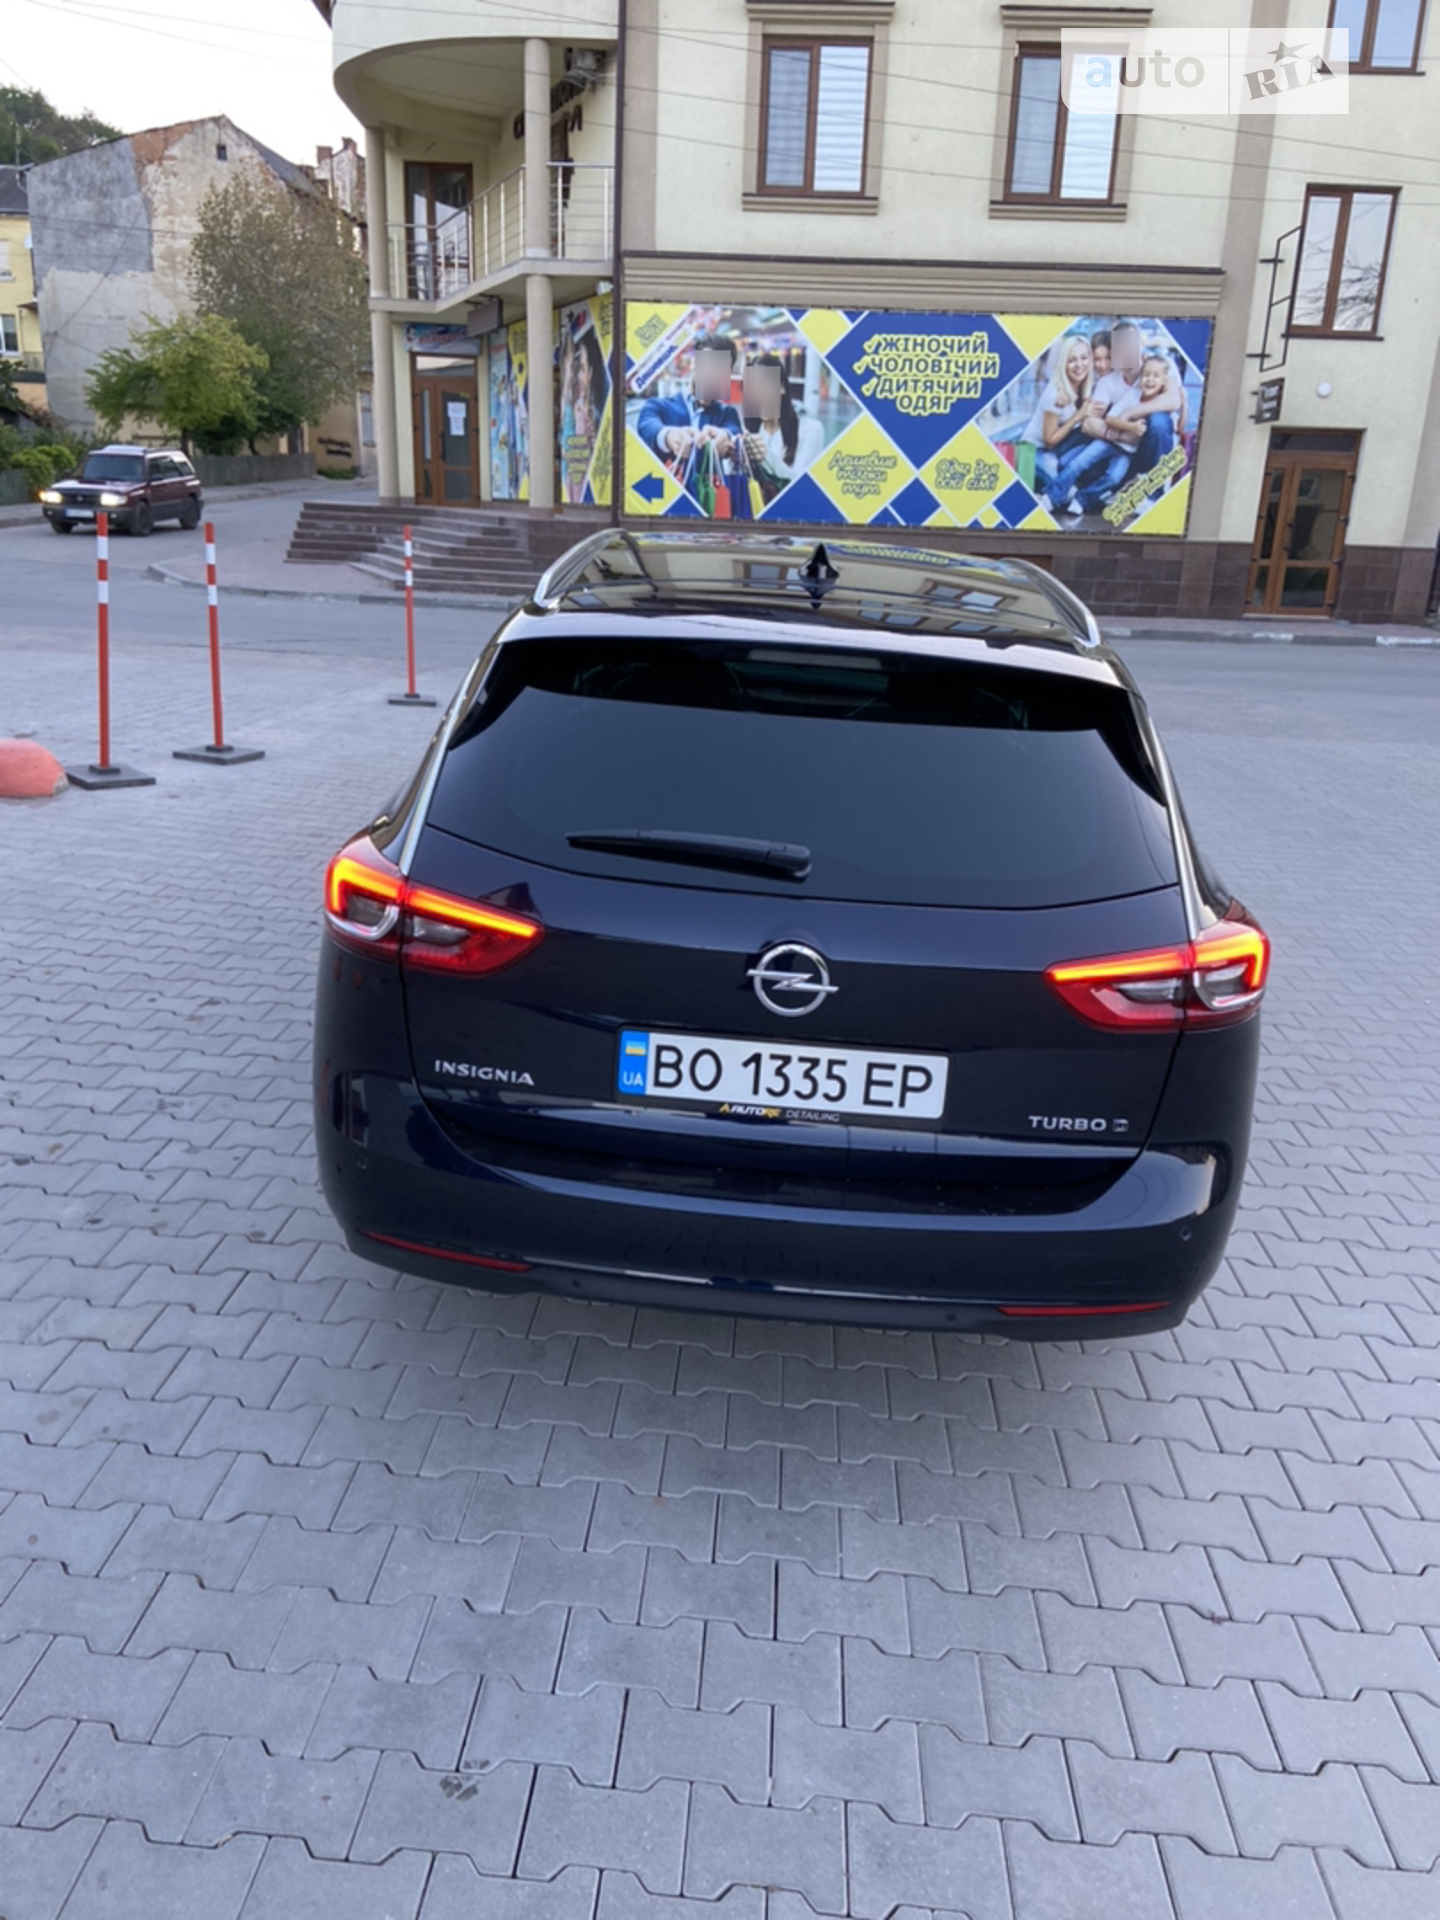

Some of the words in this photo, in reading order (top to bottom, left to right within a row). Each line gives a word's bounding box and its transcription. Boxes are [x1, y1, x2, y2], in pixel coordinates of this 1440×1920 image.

[881, 334, 986, 354] ЖІНОЧИЙ
[870, 355, 997, 376] ЧОЛОВІЧИЙ
[879, 376, 979, 396] ДИТЯЧИЙ
[899, 394, 954, 413] ОДЯГ
[434, 1059, 536, 1087] INSIGNIA
[623, 1071, 644, 1087] UA
[653, 1044, 723, 1092] BO
[741, 1051, 848, 1103] 1335
[863, 1062, 933, 1109] EP
[785, 1109, 840, 1122] DETAILING
[1028, 1115, 1107, 1132] TURBO
